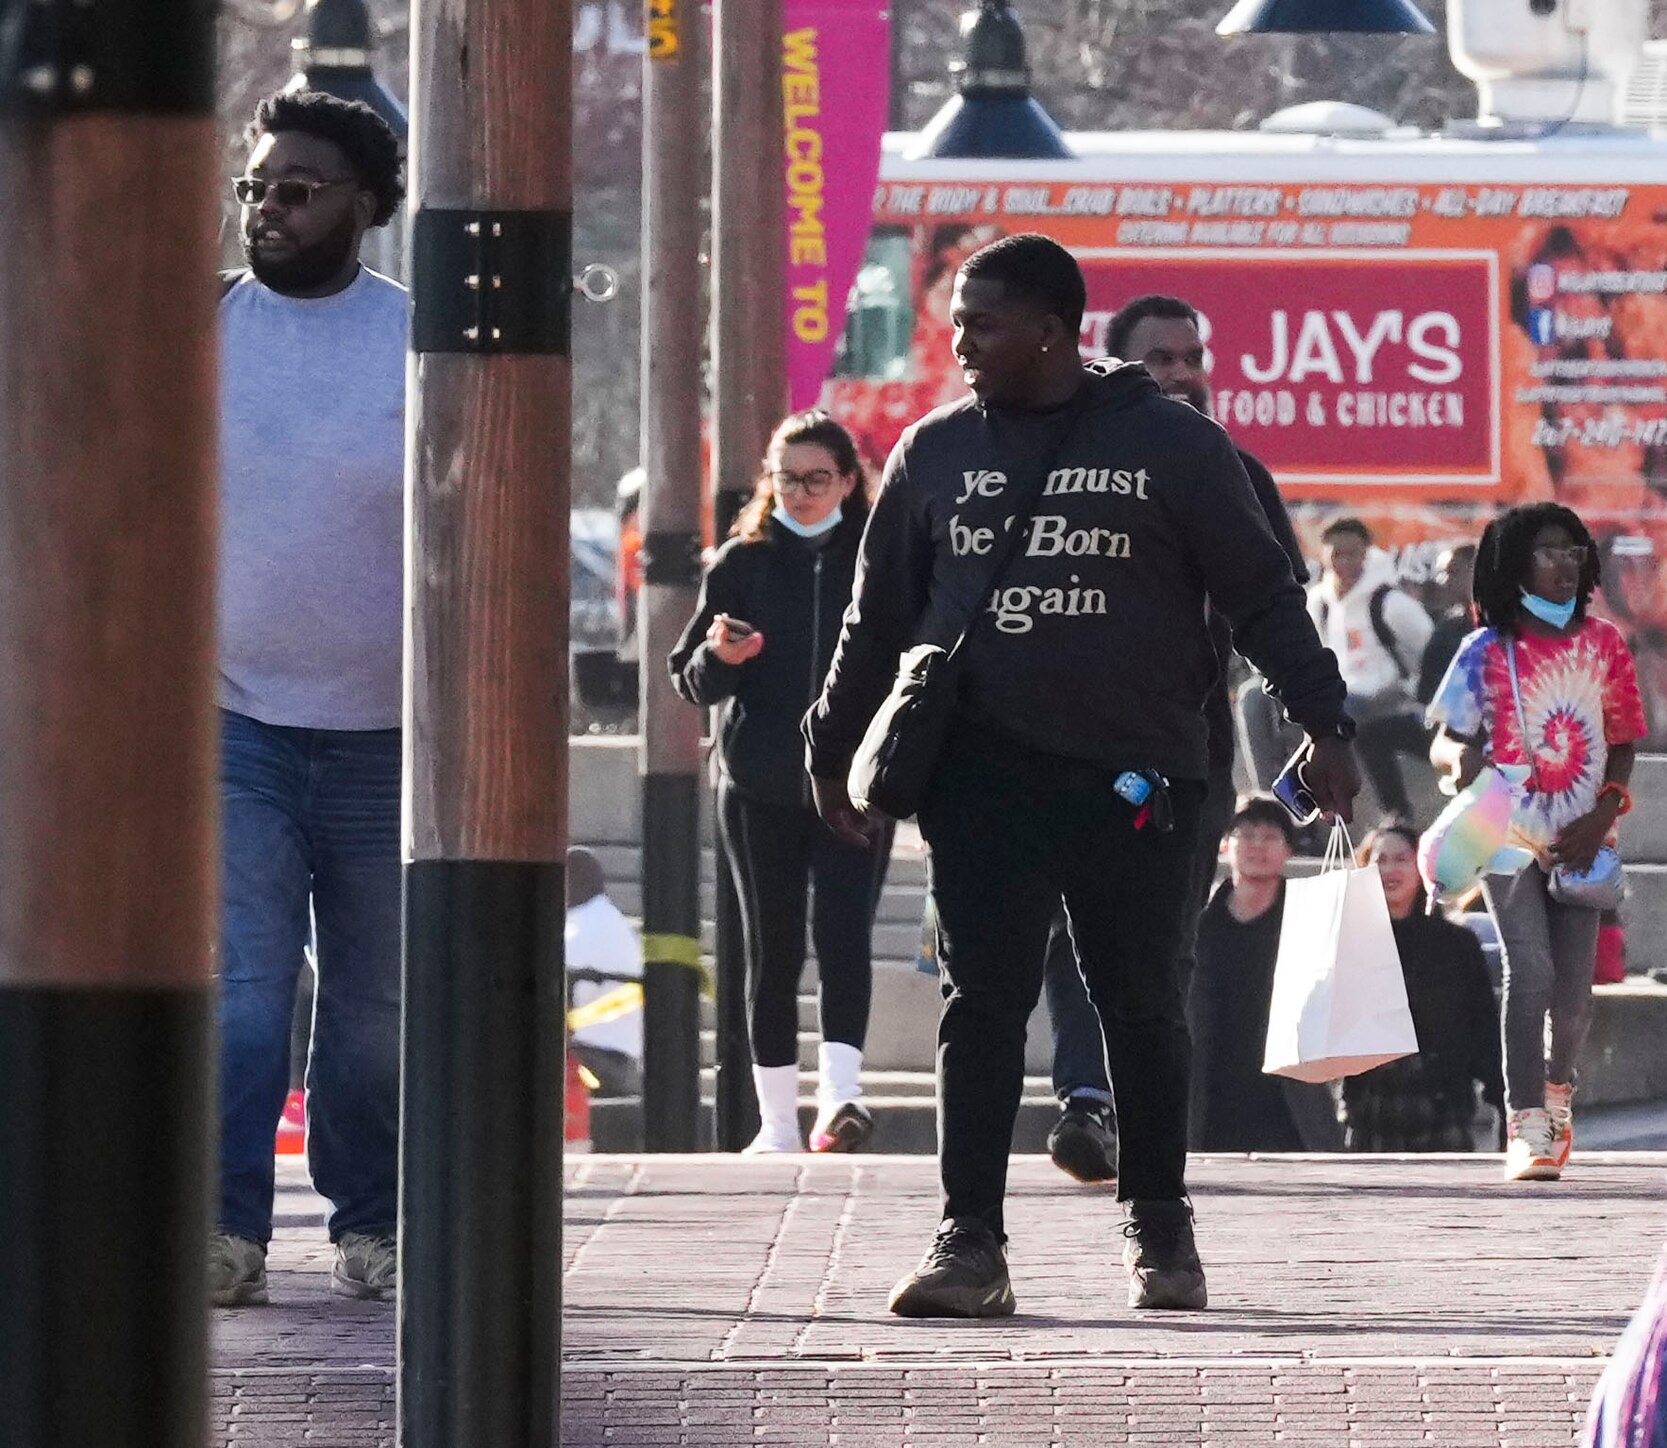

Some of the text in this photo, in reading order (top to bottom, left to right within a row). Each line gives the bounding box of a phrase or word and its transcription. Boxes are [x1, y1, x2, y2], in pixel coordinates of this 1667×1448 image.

[781, 27, 829, 343] WELCOME TO
[1186, 187, 1282, 217] PLATTERS
[1240, 309, 1463, 384] JAY'S
[1207, 389, 1464, 428] FOOD & CHICKEN
[955, 467, 1151, 504] ye must
[949, 514, 1132, 558] be Born
